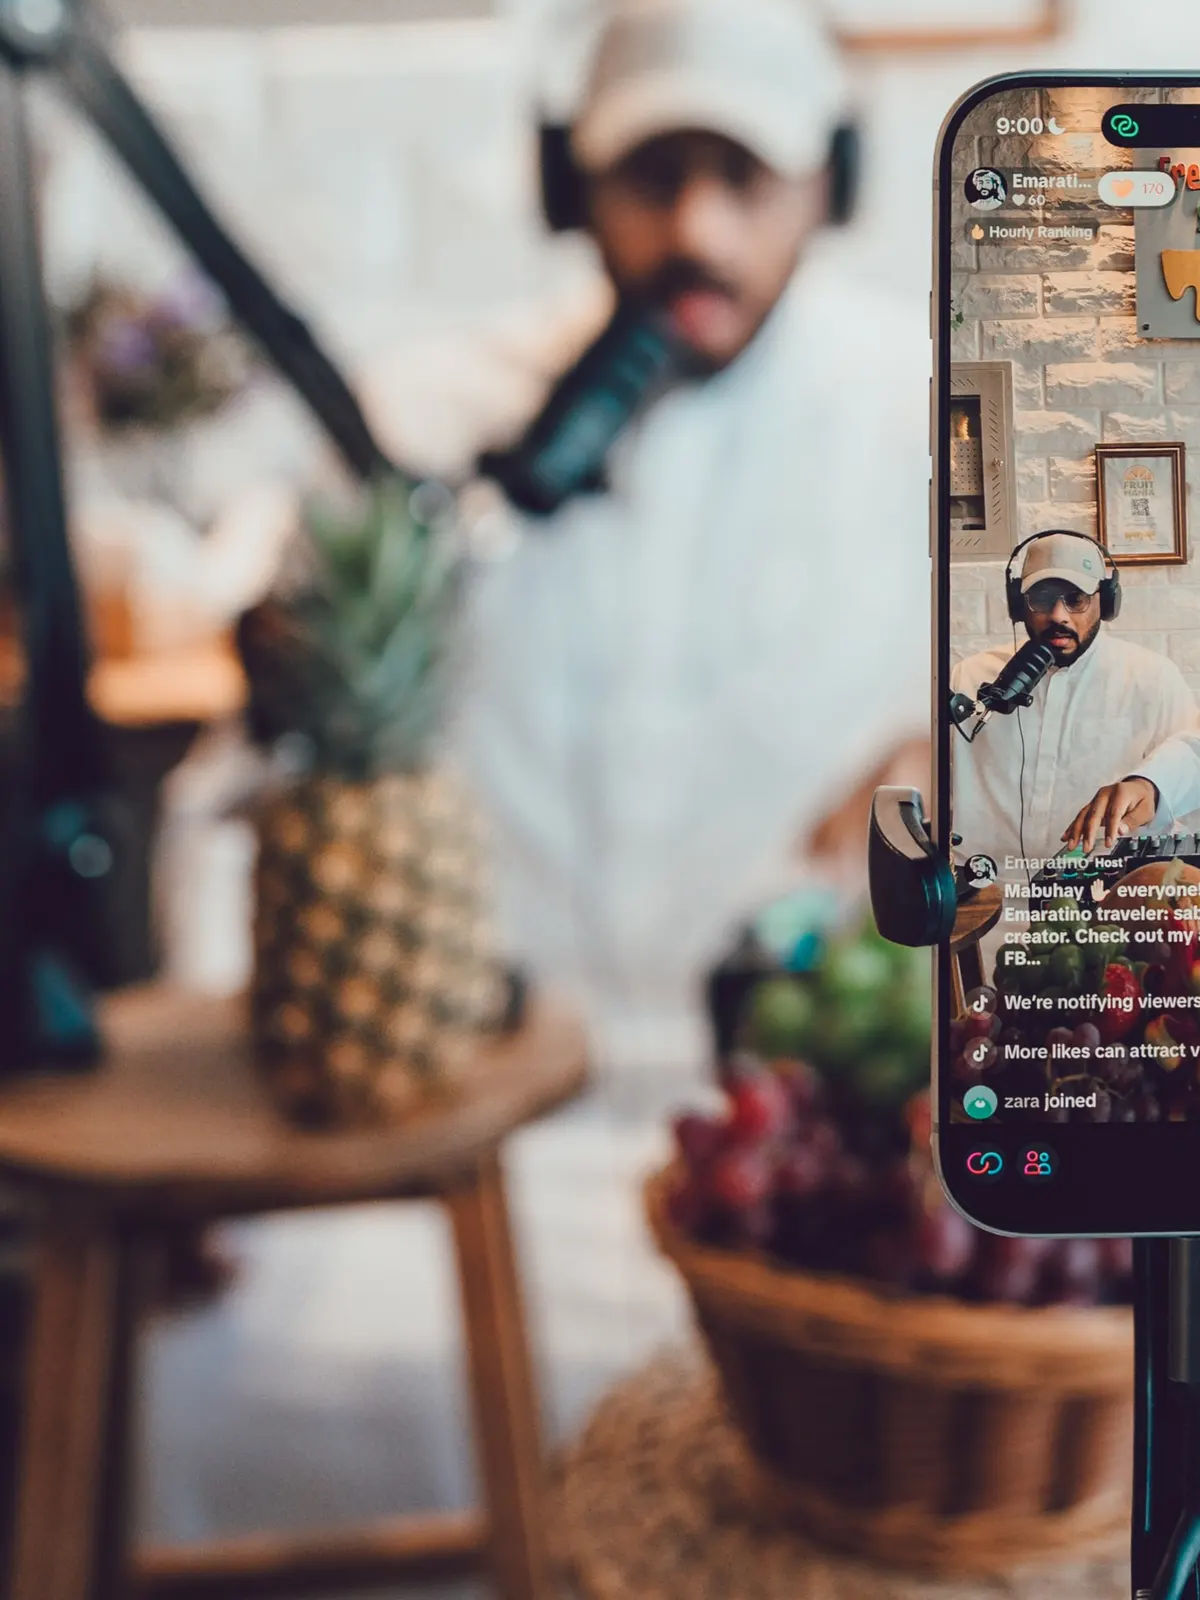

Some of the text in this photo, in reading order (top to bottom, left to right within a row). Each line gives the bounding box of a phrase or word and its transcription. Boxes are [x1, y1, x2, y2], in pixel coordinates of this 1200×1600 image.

[996, 117, 1044, 135] 9:00
[1012, 173, 1092, 189] Emarati...
[1143, 183, 1164, 195] 170
[1028, 194, 1046, 206] 60
[989, 225, 1093, 240] Hourly Ranking
[1004, 855, 1123, 869] Emaratino Host
[1004, 883, 1084, 901] Mabuhay
[1004, 907, 1092, 921] Emaratino
[1096, 905, 1168, 921] traveler:
[1004, 930, 1070, 944] creator.
[1075, 929, 1130, 943] Check
[1134, 930, 1163, 943] out
[1167, 930, 1194, 945] my
[1004, 951, 1041, 966] FB...
[1004, 994, 1053, 1009] We’re
[1057, 993, 1134, 1012] notifying
[1004, 1045, 1048, 1059] More
[1052, 1043, 1091, 1058] likes
[1095, 1046, 1125, 1058] can
[1129, 1043, 1187, 1058] attract
[1004, 1093, 1097, 1111] zara joined
